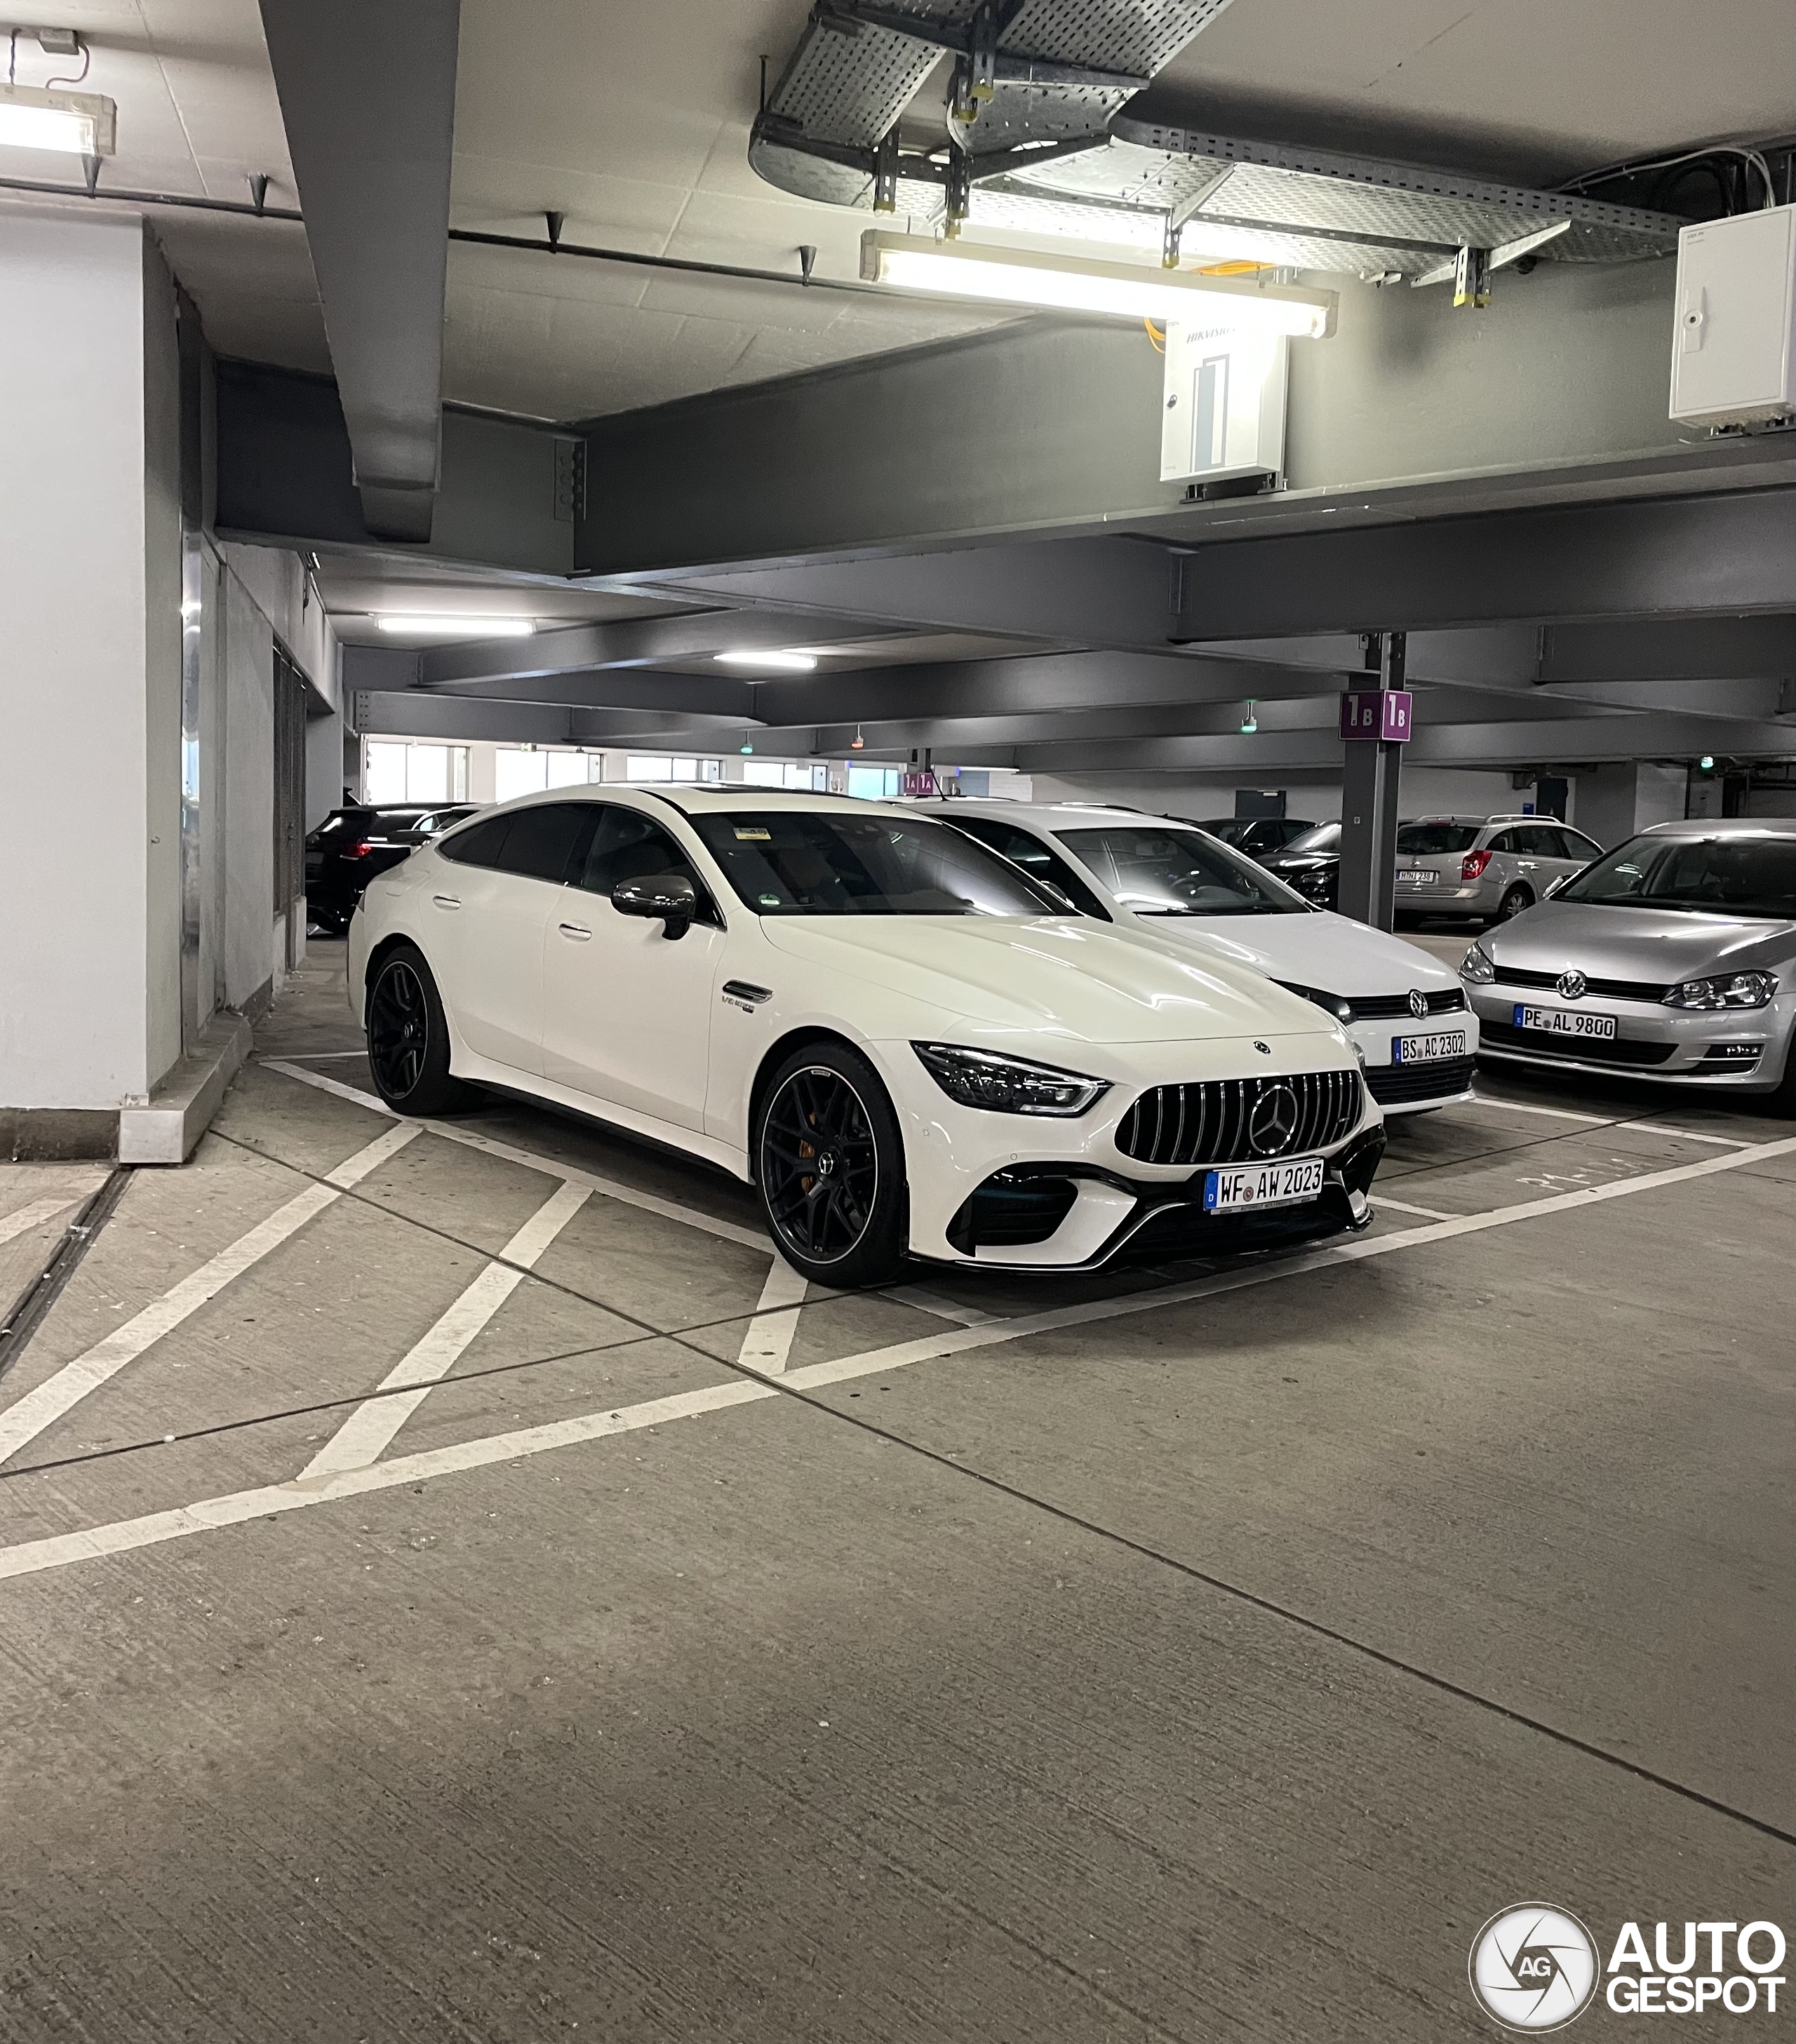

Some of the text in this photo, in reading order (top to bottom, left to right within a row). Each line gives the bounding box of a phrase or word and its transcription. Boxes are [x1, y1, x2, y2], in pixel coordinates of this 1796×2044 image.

[1186, 328, 1235, 344] HIKVISIO
[1524, 1009, 1542, 1027] PE
[1553, 1014, 1571, 1031] AL
[1576, 1016, 1614, 1037] 9800
[1402, 1040, 1416, 1059] BS
[1425, 1037, 1437, 1057] AC
[1440, 1035, 1463, 1055] 2302
[1221, 1174, 1245, 1203] WF
[1256, 1170, 1280, 1199] AW
[1283, 1164, 1322, 1195] 2023
